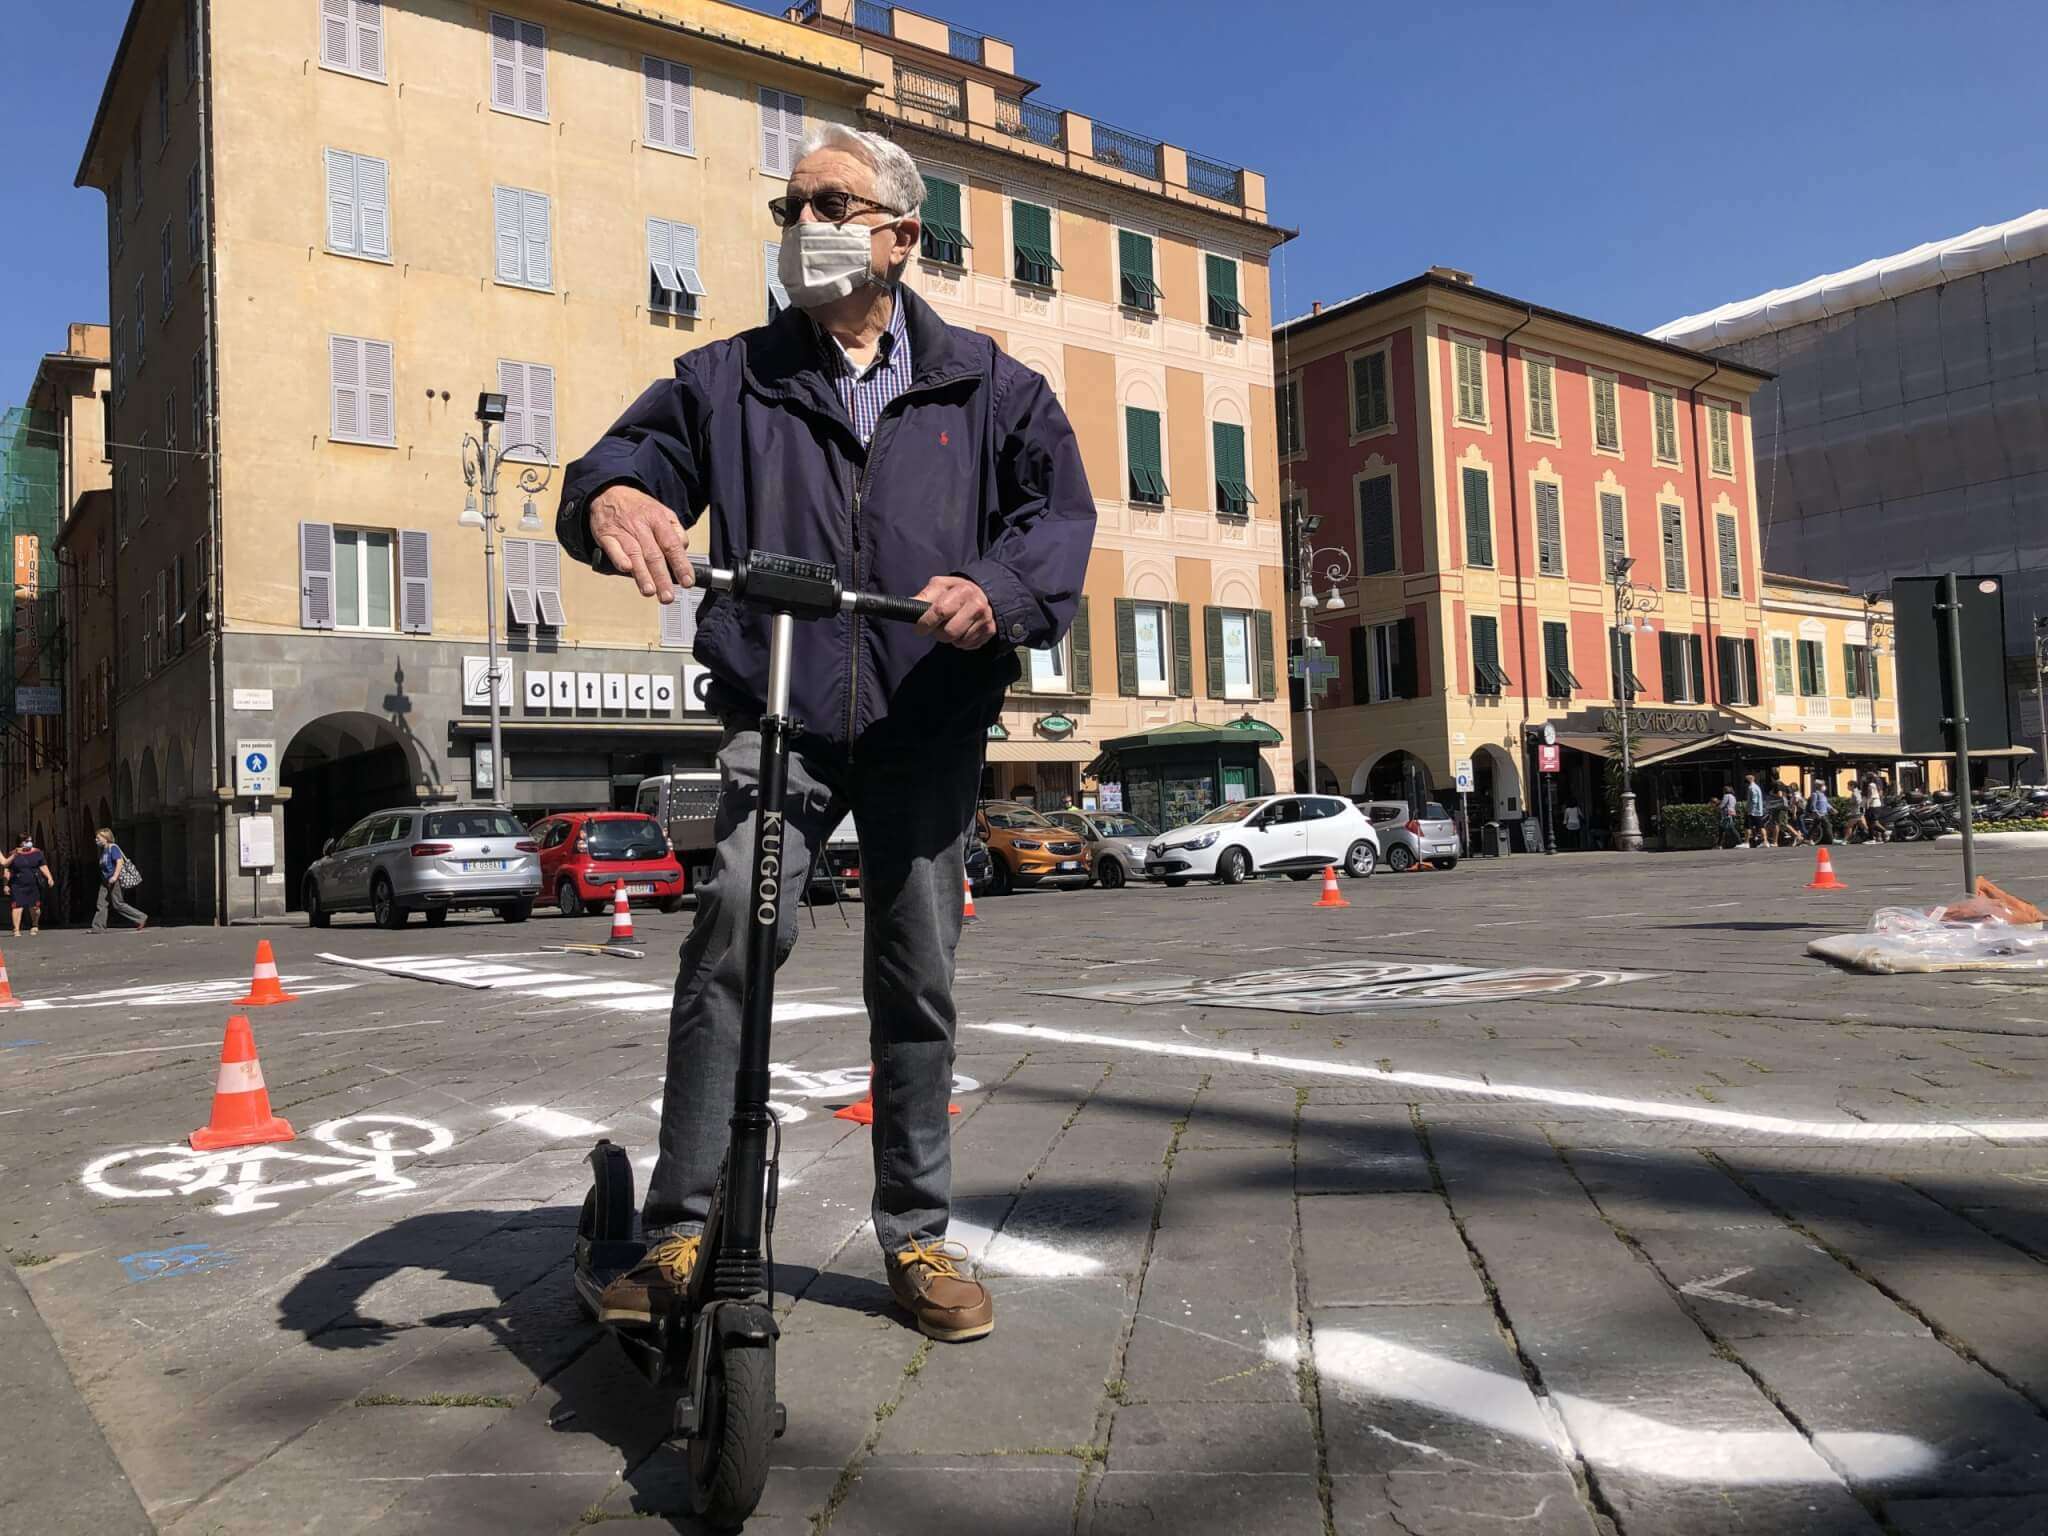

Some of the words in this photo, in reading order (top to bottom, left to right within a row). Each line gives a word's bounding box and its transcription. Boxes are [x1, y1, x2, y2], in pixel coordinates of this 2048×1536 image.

[29, 539, 38, 649] FIORDALISO
[529, 680, 671, 702] ottico
[757, 810, 783, 926] KUGOO
